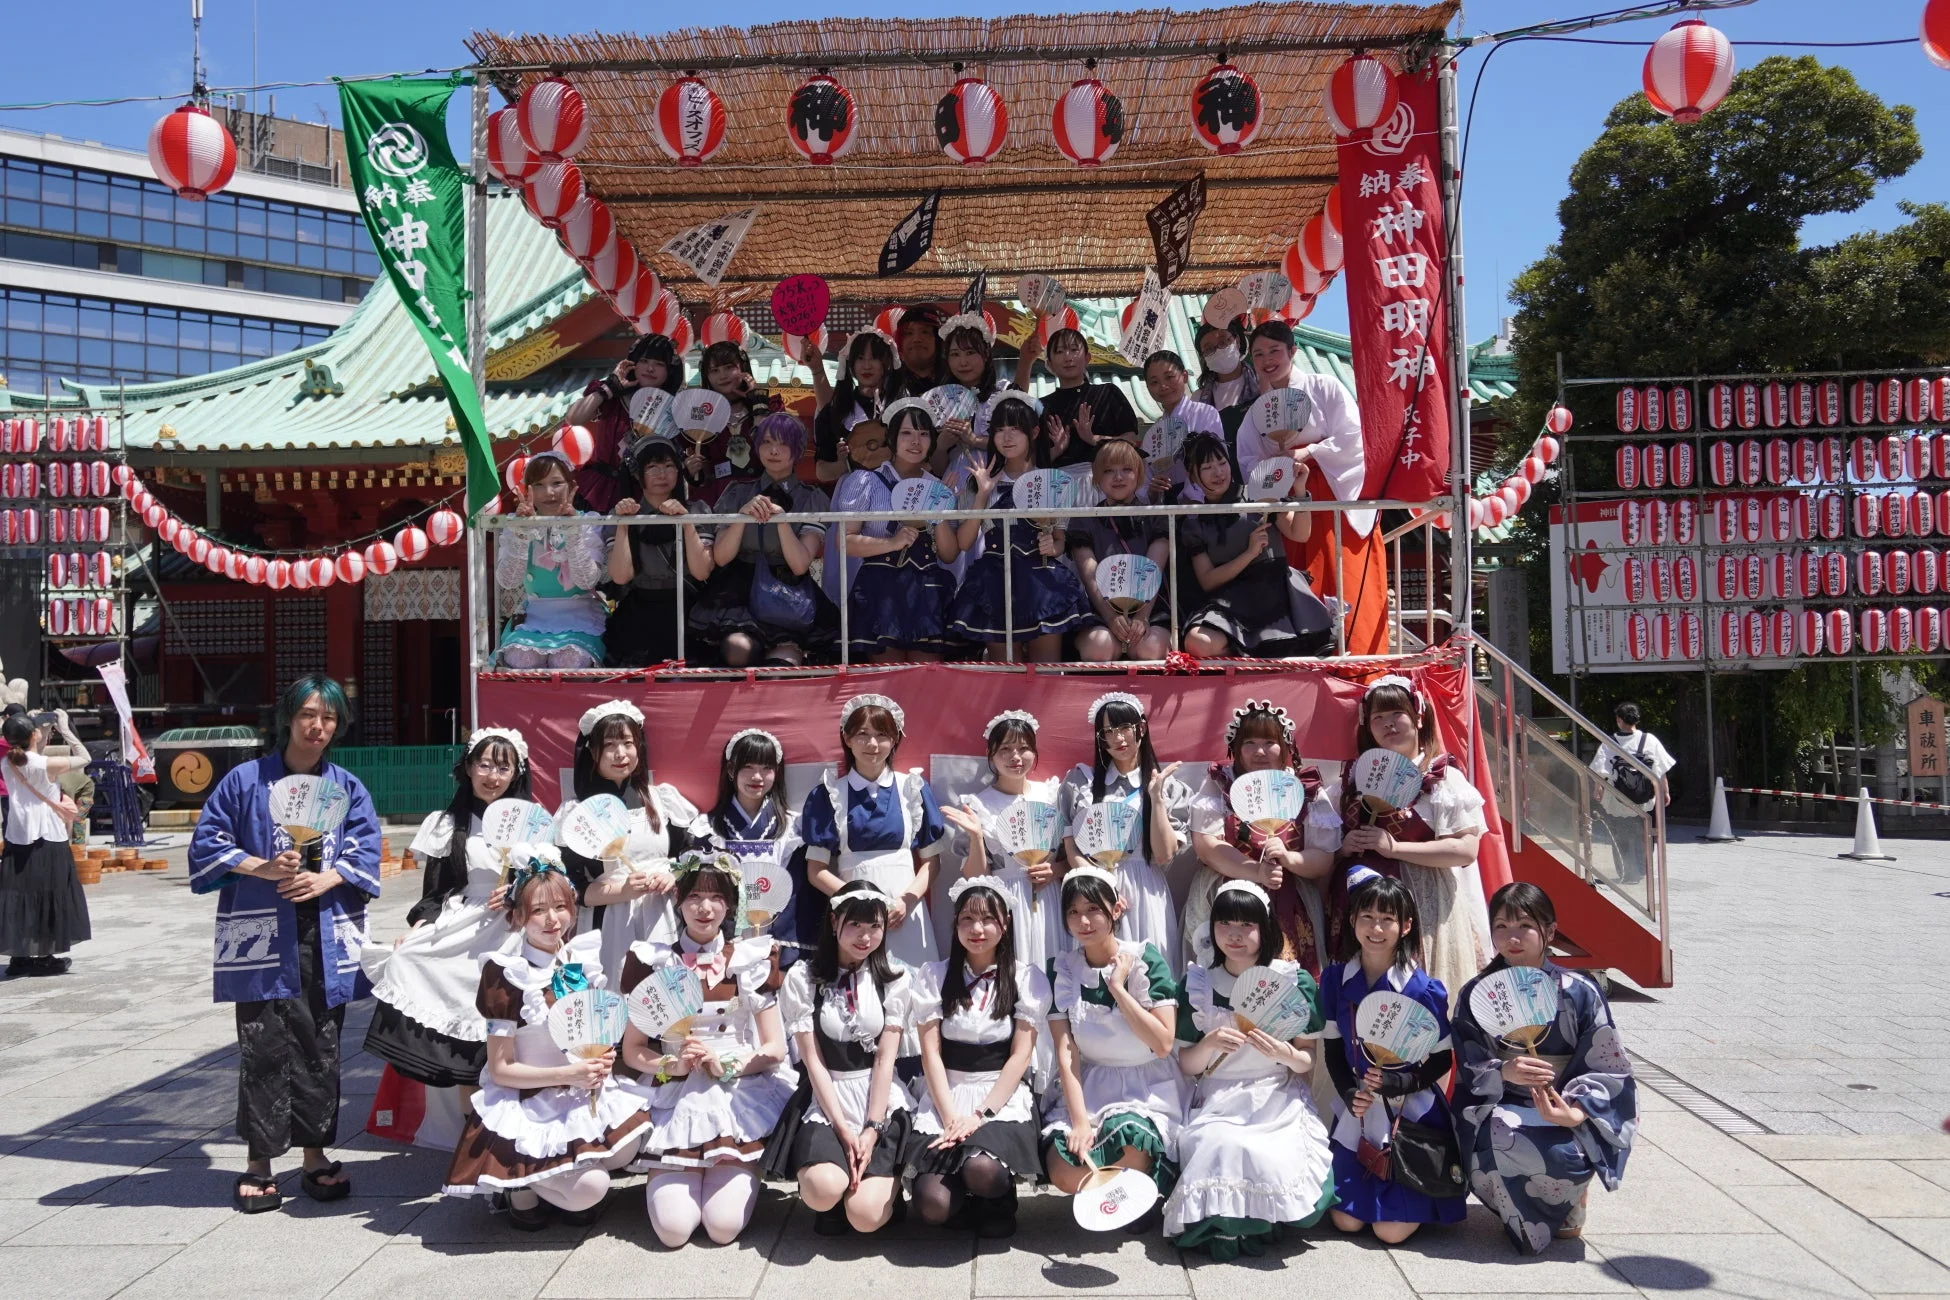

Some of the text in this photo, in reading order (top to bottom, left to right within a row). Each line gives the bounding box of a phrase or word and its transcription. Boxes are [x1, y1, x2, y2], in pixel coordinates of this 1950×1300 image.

[363, 177, 437, 212] 奉納
[1360, 162, 1430, 198] 奉納
[1371, 200, 1436, 470] 神田明神 氏子中
[1918, 709, 1938, 771] 車祓所
[1374, 755, 1390, 790] 納涼祭り
[294, 781, 310, 819] 納涼祭り
[1016, 809, 1026, 845] 納涼祭り
[1093, 810, 1104, 845] 納涼祭り
[646, 985, 669, 1021] 納涼祭り
[1251, 980, 1280, 1013] 納涼祭り
[1494, 980, 1514, 1023] 納涼祭り
[574, 998, 584, 1039] 納涼祭り
[1380, 1001, 1401, 1039] 納涼祭り
